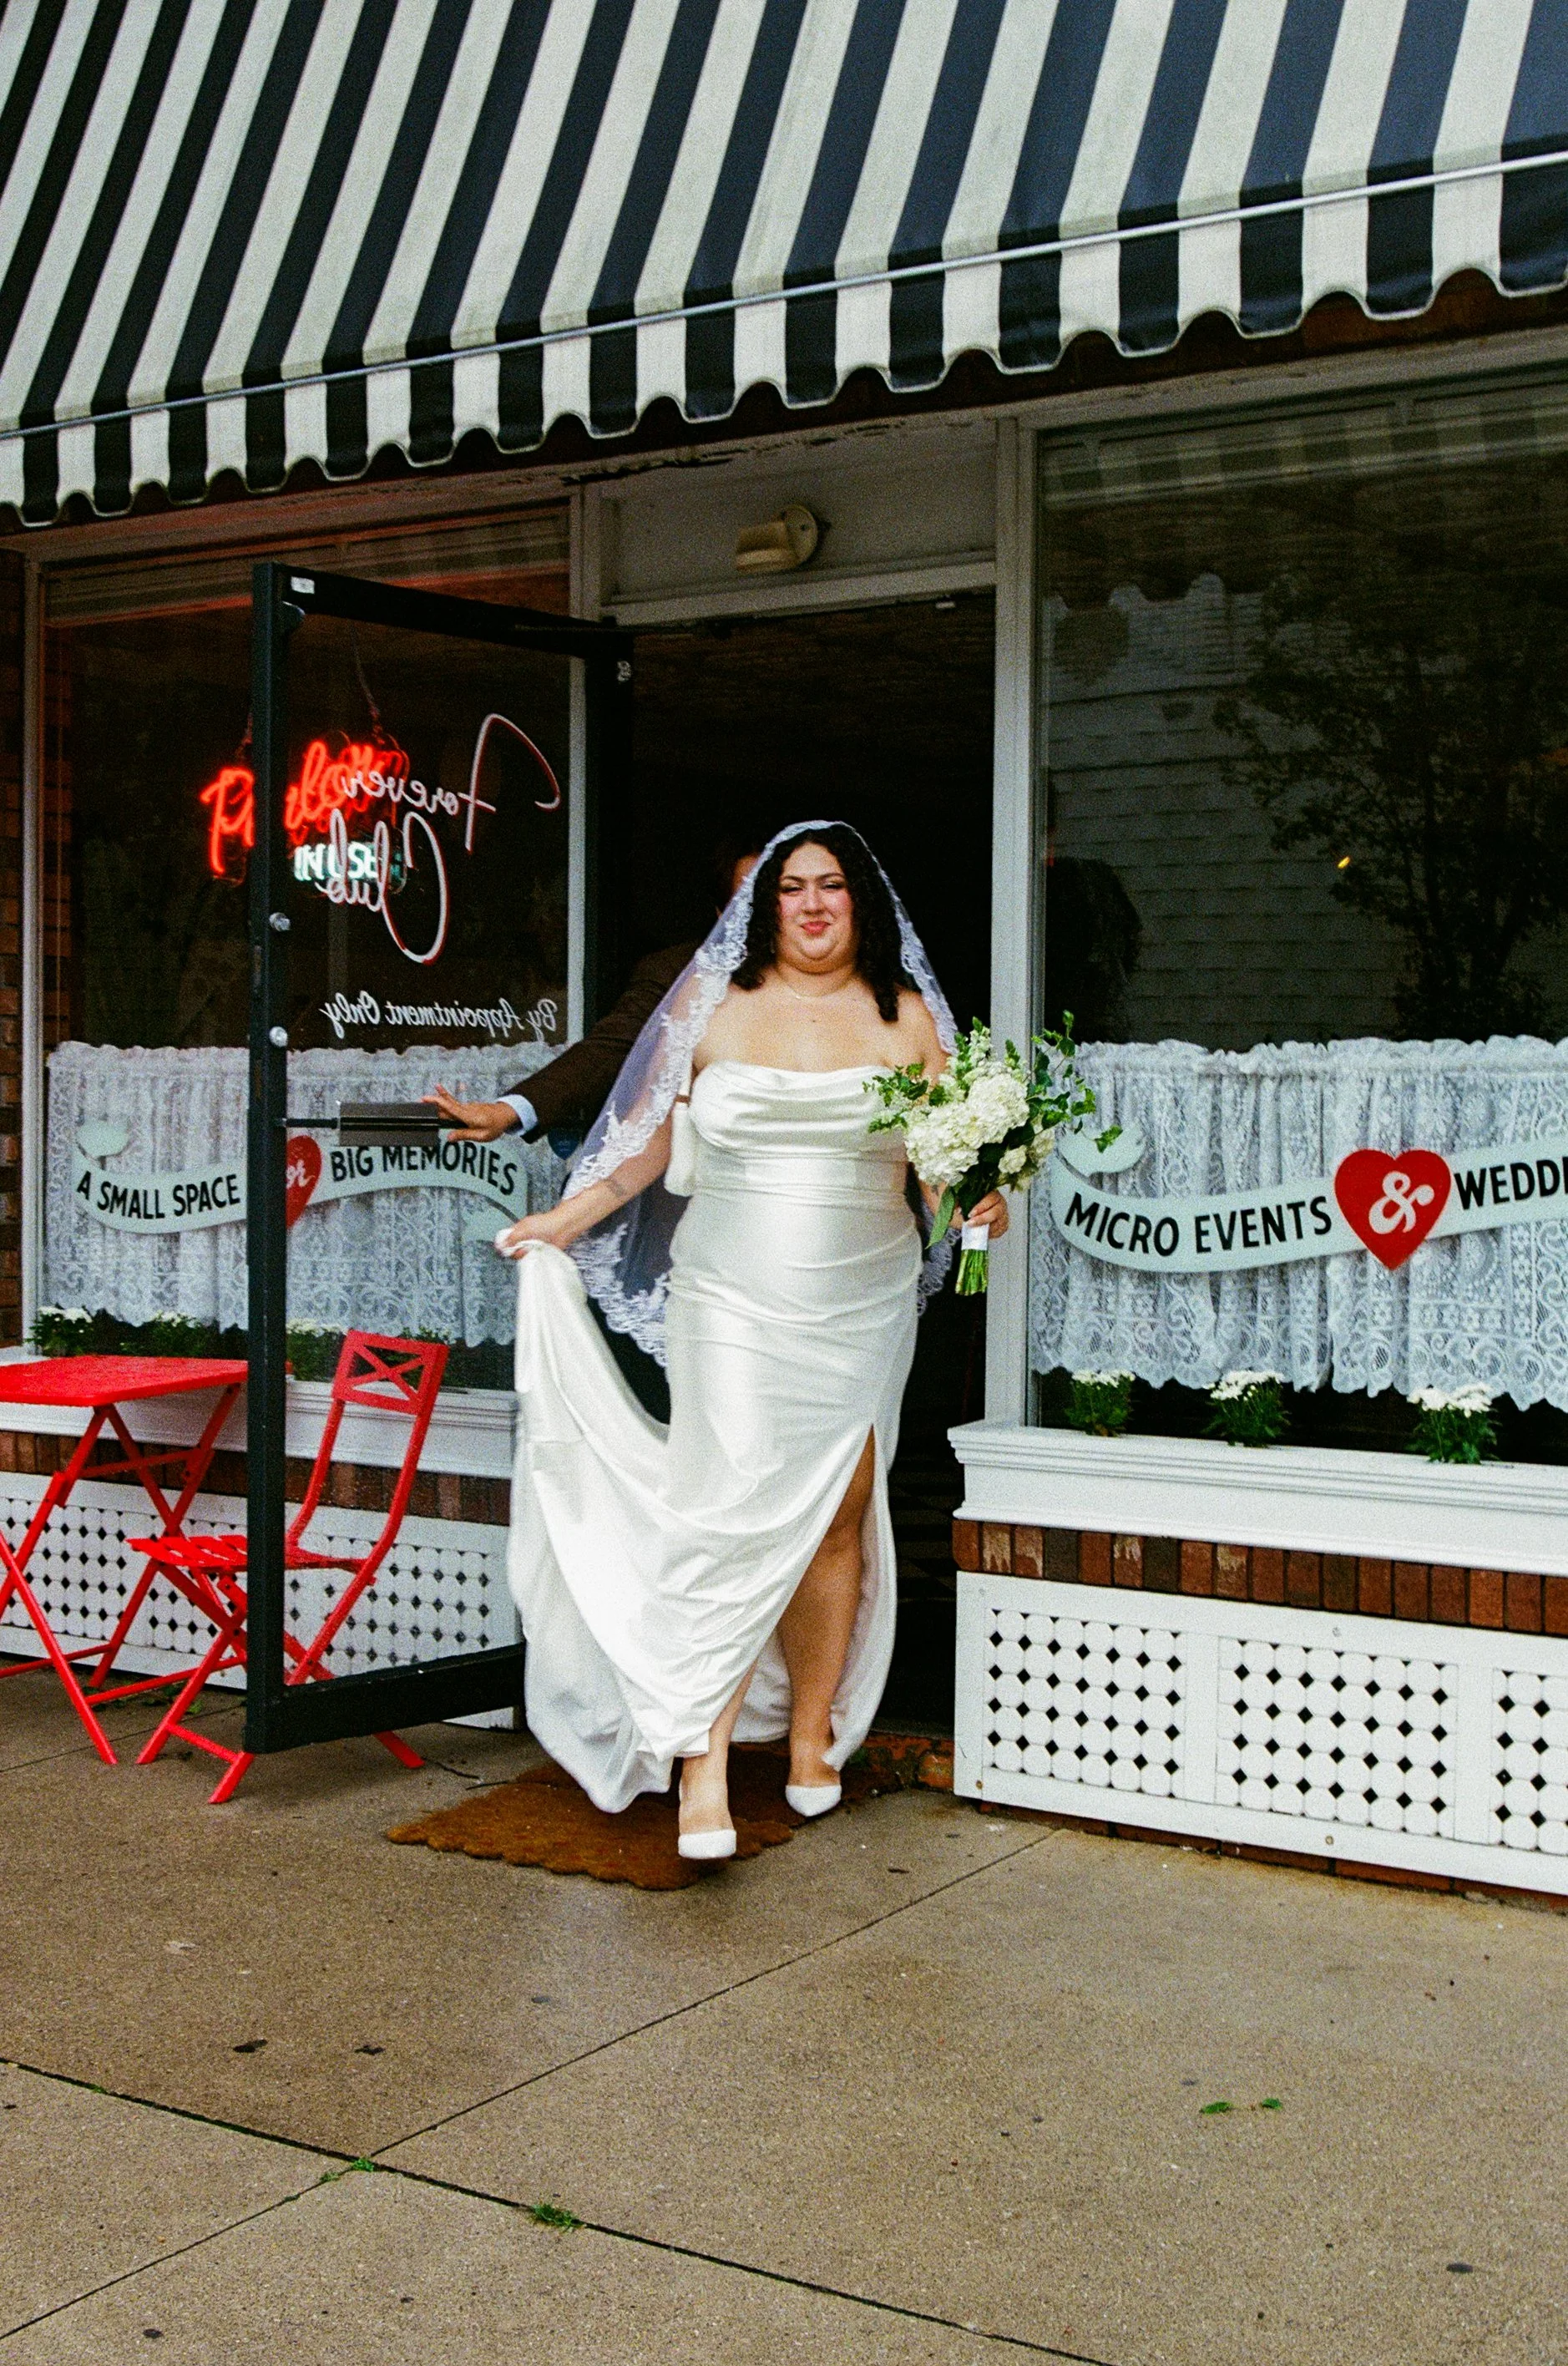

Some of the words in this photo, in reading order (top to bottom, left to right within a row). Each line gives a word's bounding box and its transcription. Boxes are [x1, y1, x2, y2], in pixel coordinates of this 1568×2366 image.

[76, 1170, 92, 1200] A
[97, 1181, 165, 1219] SMALL
[172, 1174, 240, 1217] SPACE
[330, 1146, 374, 1182] BIG
[382, 1140, 518, 1196] MEMORIES
[1065, 1193, 1180, 1258] MICRO
[1195, 1196, 1333, 1254] EVENTS
[1369, 1171, 1435, 1235] &
